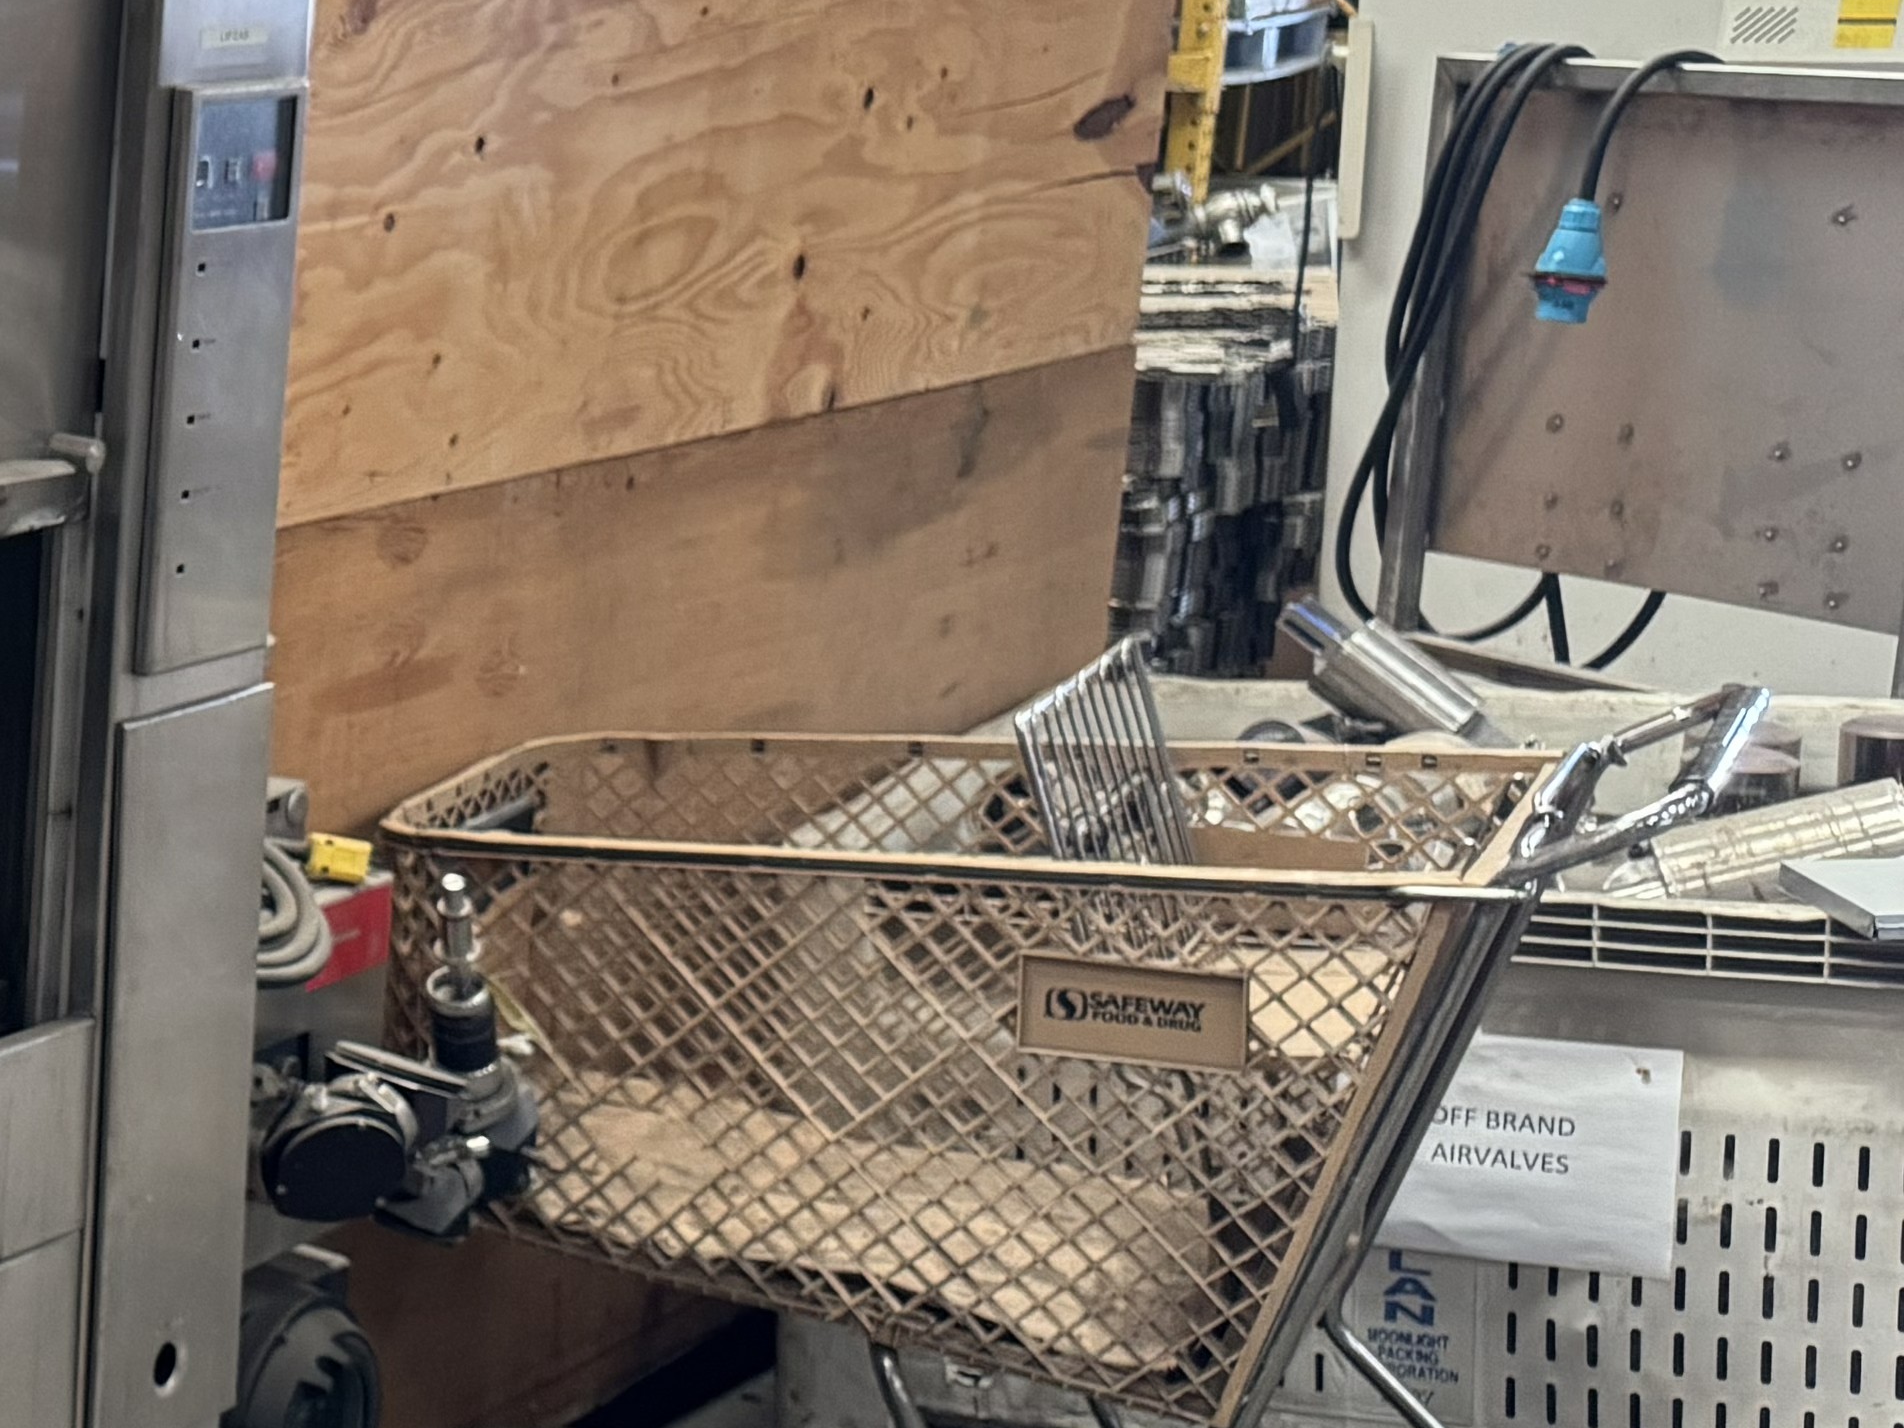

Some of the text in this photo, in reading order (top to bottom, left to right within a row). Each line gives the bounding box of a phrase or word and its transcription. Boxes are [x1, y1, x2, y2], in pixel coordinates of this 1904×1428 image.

[1090, 990, 1206, 1020] SAFEWAY
[1091, 1010, 1139, 1026] FOOD
[1156, 1015, 1202, 1033] DRUG
[1485, 1109, 1576, 1137] BRAND
[1430, 1142, 1570, 1175] AIRVALVES
[1377, 1344, 1439, 1365] PACKING
